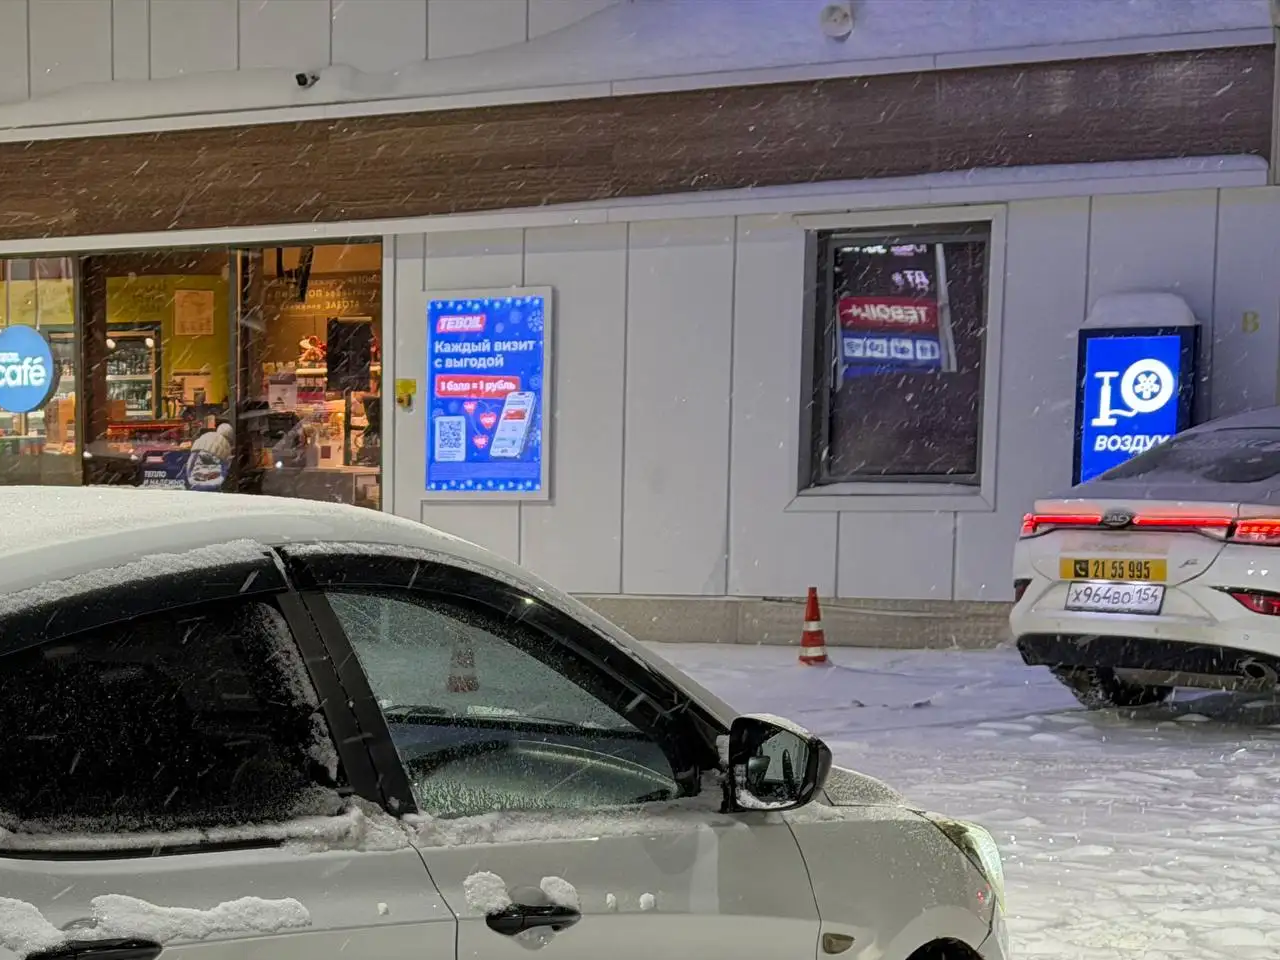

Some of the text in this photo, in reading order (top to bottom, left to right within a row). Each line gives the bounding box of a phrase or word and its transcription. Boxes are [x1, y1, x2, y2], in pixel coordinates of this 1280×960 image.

[438, 317, 483, 330] TEBOIL
[434, 340, 536, 354] Каждый визит
[434, 354, 504, 368] с выгодой
[440, 381, 446, 390] 1
[480, 381, 484, 390] 1
[1093, 560, 1150, 579] 21 55 995
[1135, 587, 1159, 602] 154
